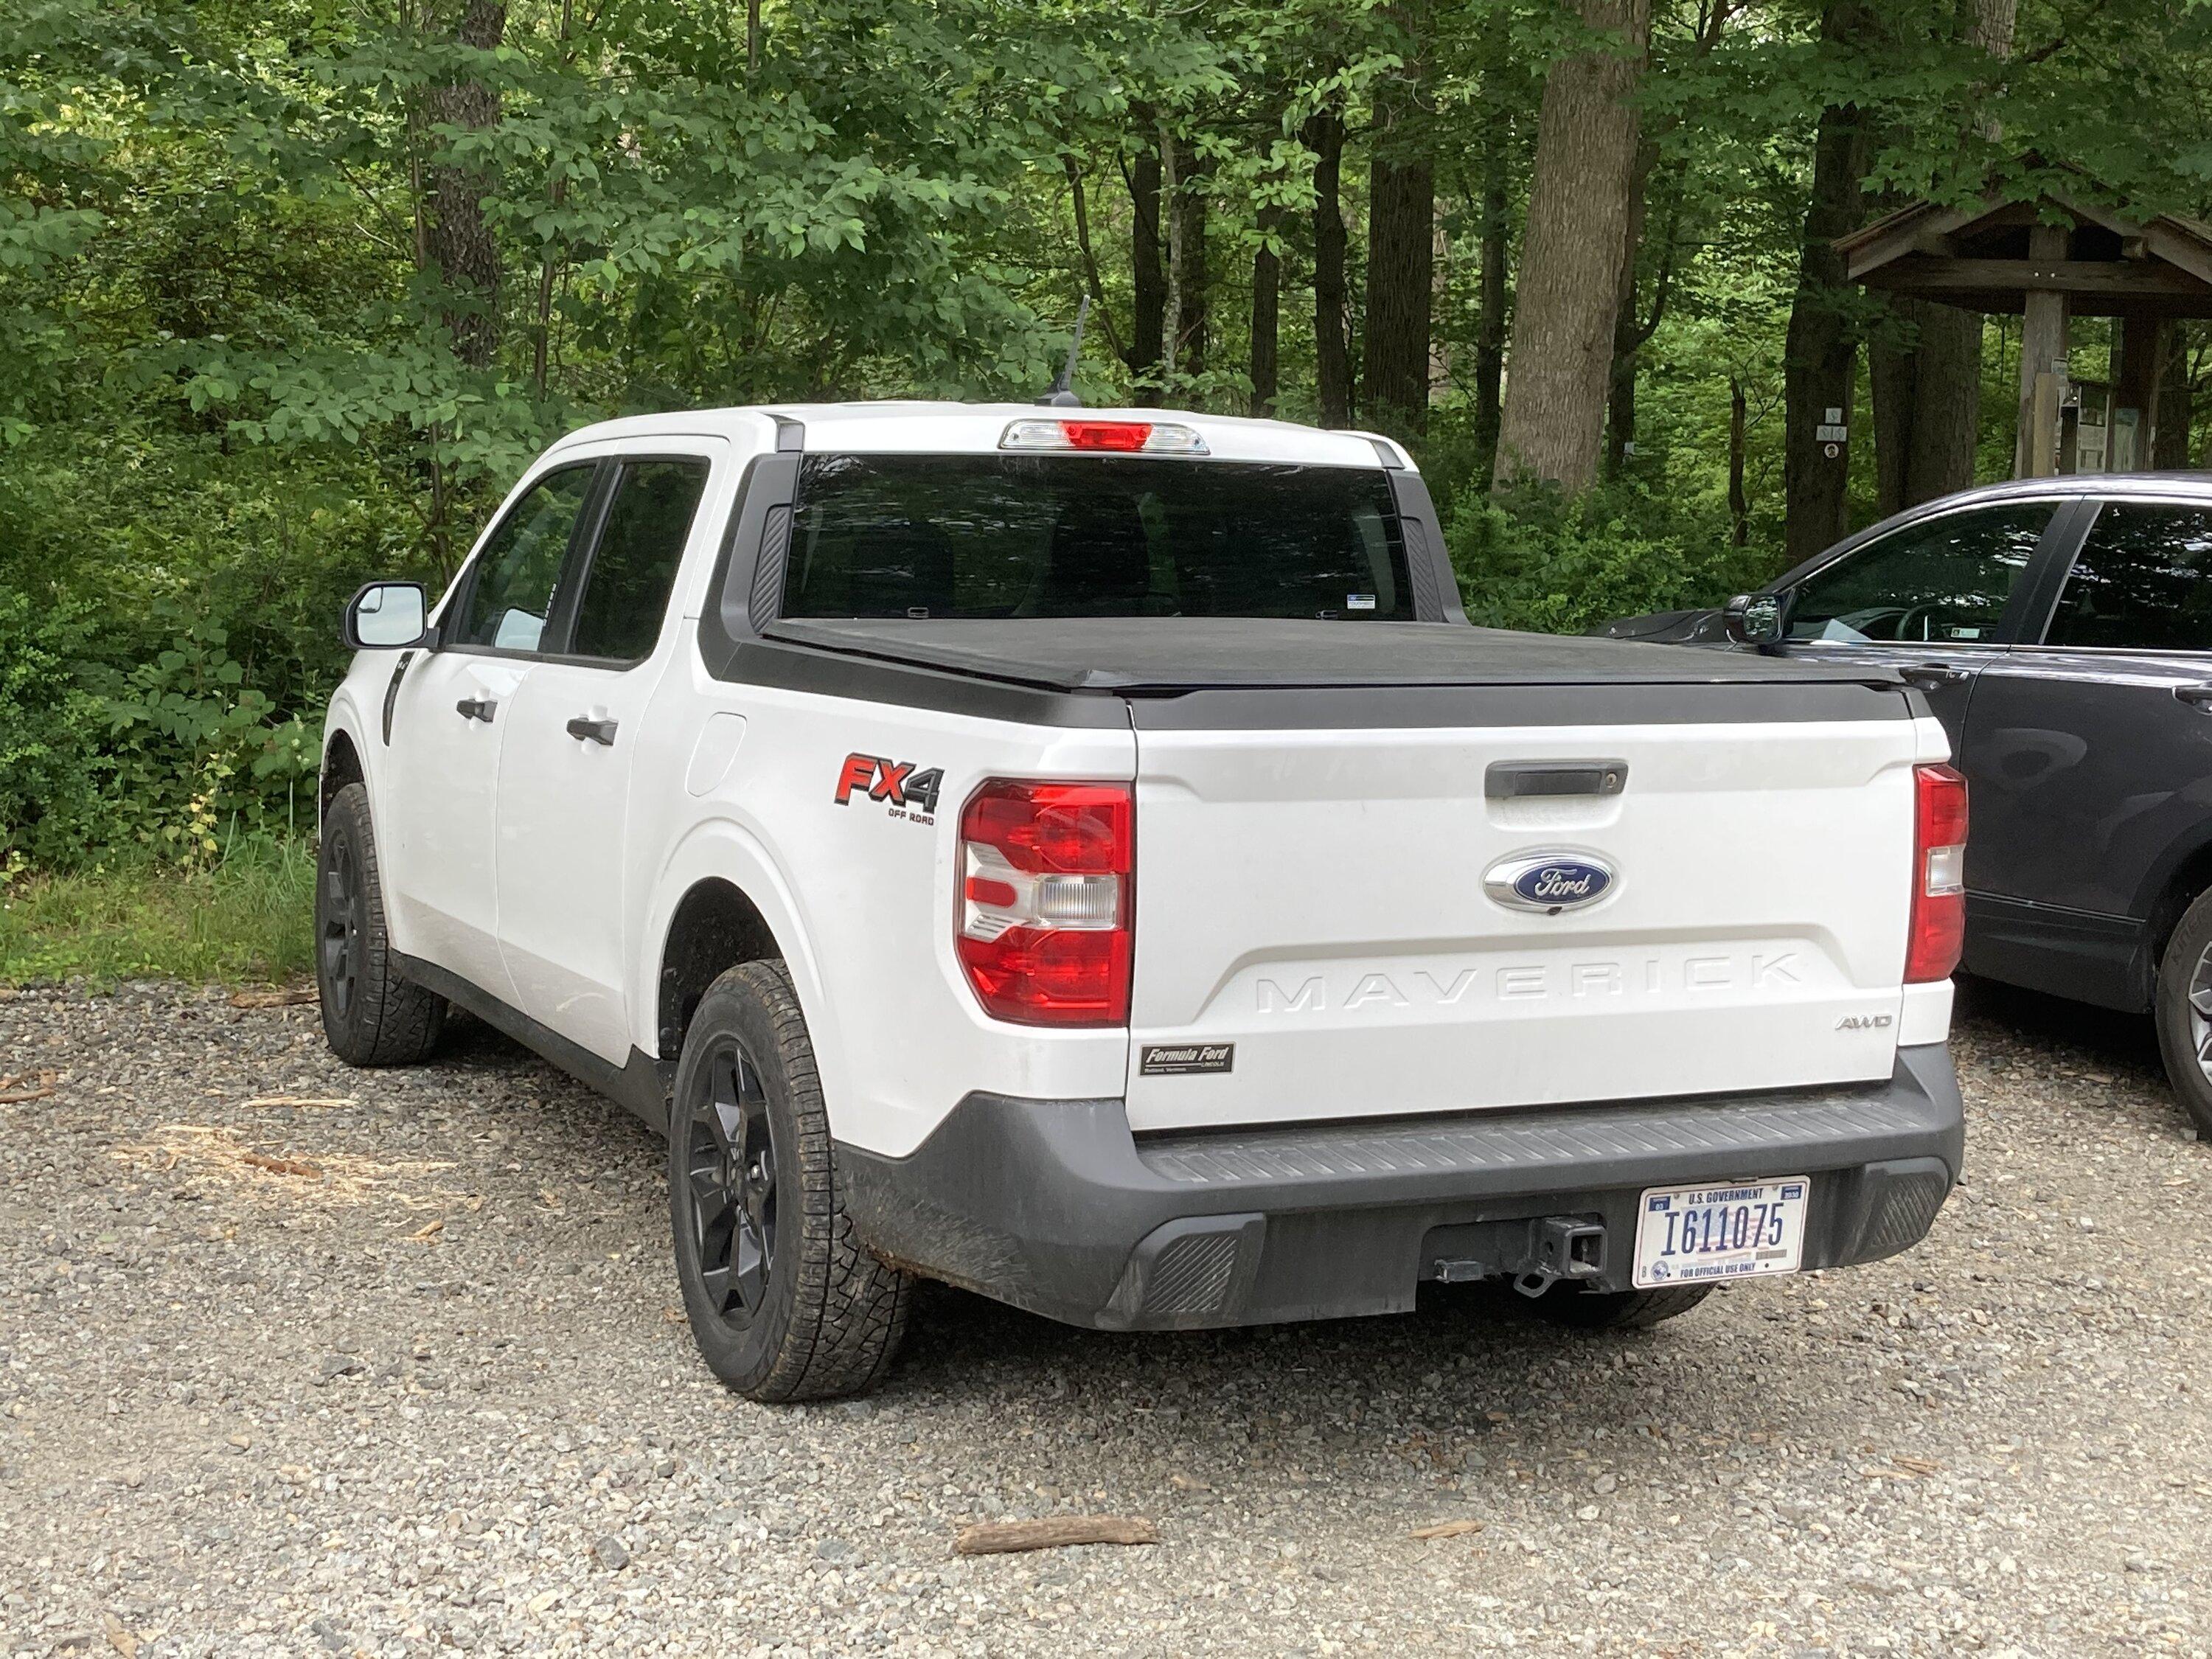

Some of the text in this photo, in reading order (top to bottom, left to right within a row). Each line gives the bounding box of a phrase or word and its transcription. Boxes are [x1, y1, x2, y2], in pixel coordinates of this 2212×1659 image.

[834, 752, 945, 814] FX4
[888, 808, 934, 826] OFF ROAD
[1534, 868, 1592, 896] Ford
[1256, 953, 1801, 1014] MAVERICK
[1834, 1013, 1892, 1031] AWD
[1146, 1046, 1229, 1063] Formula Ford
[1688, 1188, 1764, 1205] U.S. GOVERNMENT
[1660, 1202, 1784, 1256] I611075
[1680, 1262, 1756, 1278] FOR OFFICIAL USE ONLY
